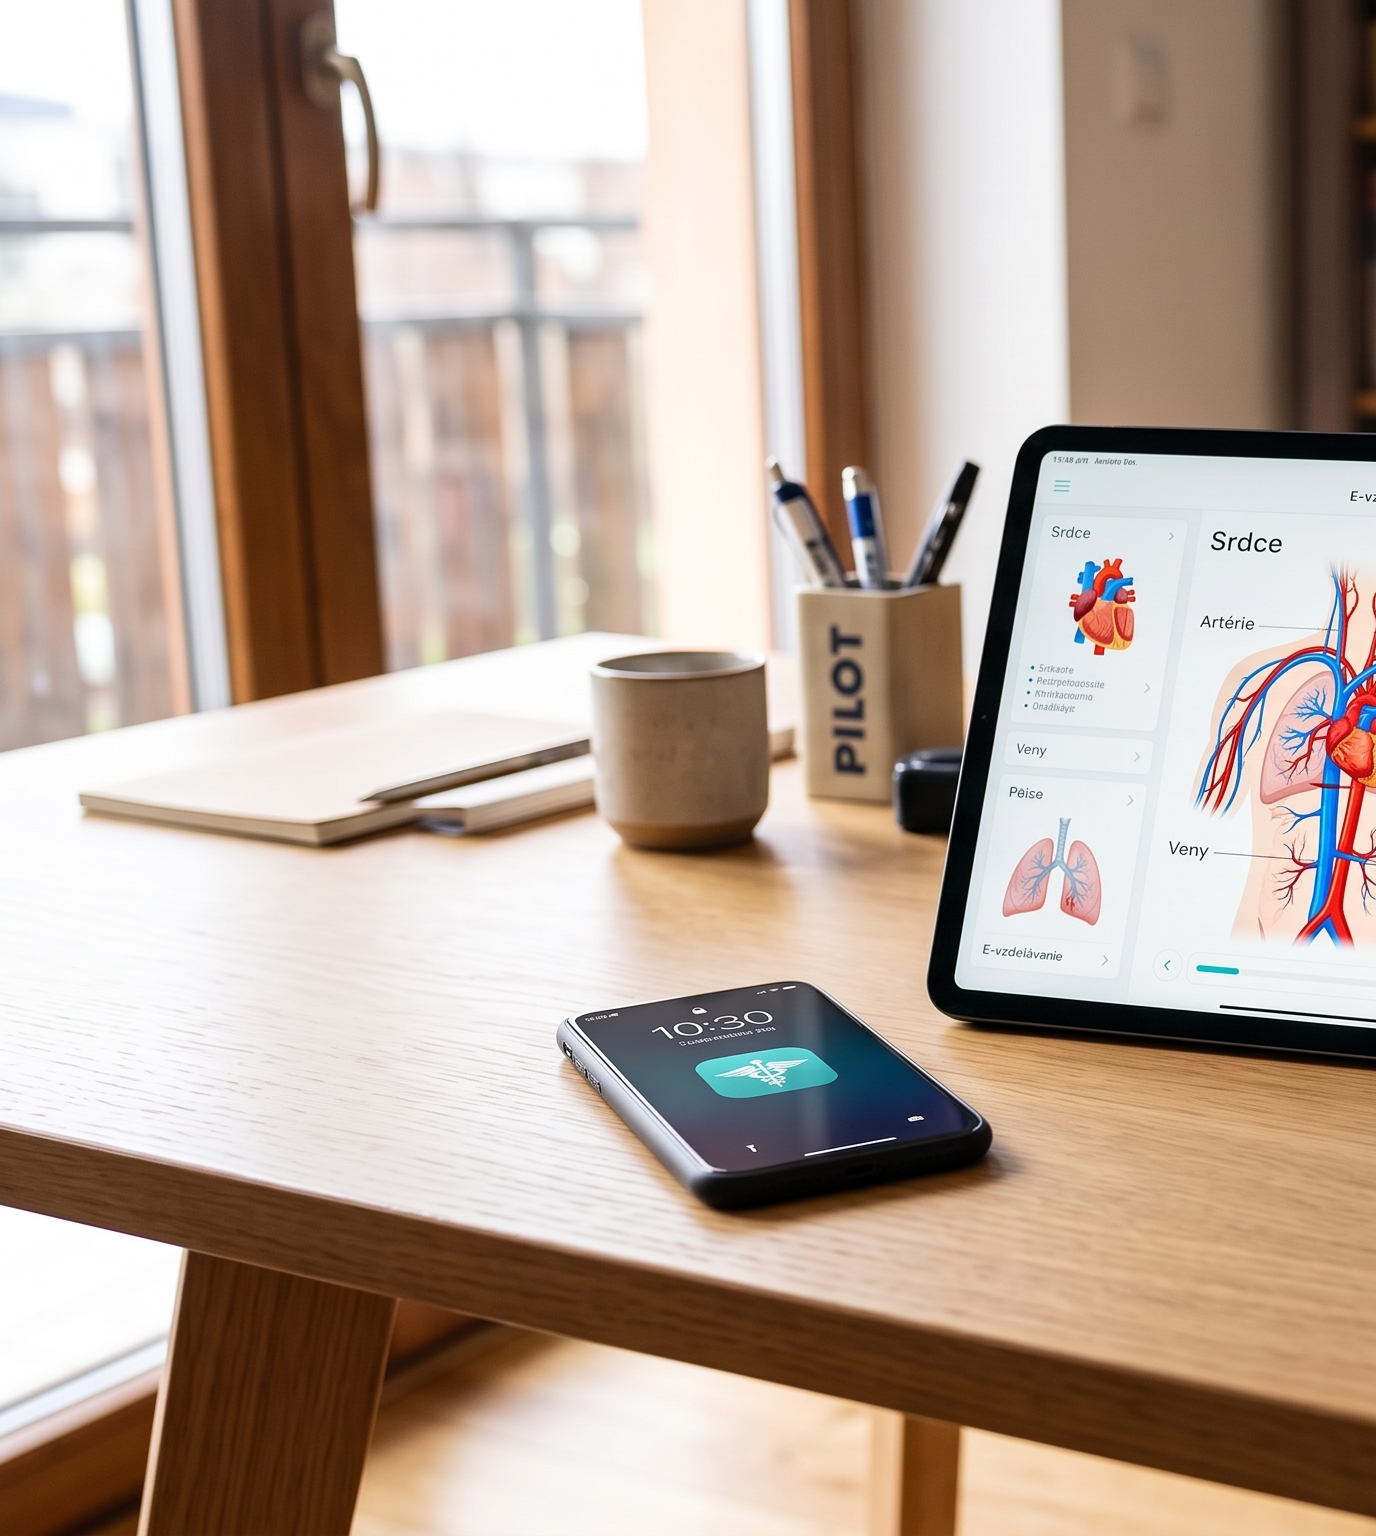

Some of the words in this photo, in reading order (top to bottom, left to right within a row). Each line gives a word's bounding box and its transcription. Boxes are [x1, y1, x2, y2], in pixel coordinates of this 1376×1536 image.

[1051, 525, 1091, 540] Srdce
[1210, 531, 1283, 554] Srdce
[1200, 615, 1255, 631] Artérie
[828, 623, 869, 777] PILOT
[1017, 743, 1048, 759] Veny
[1168, 841, 1209, 861] Veny
[651, 1010, 774, 1040] 10:30
